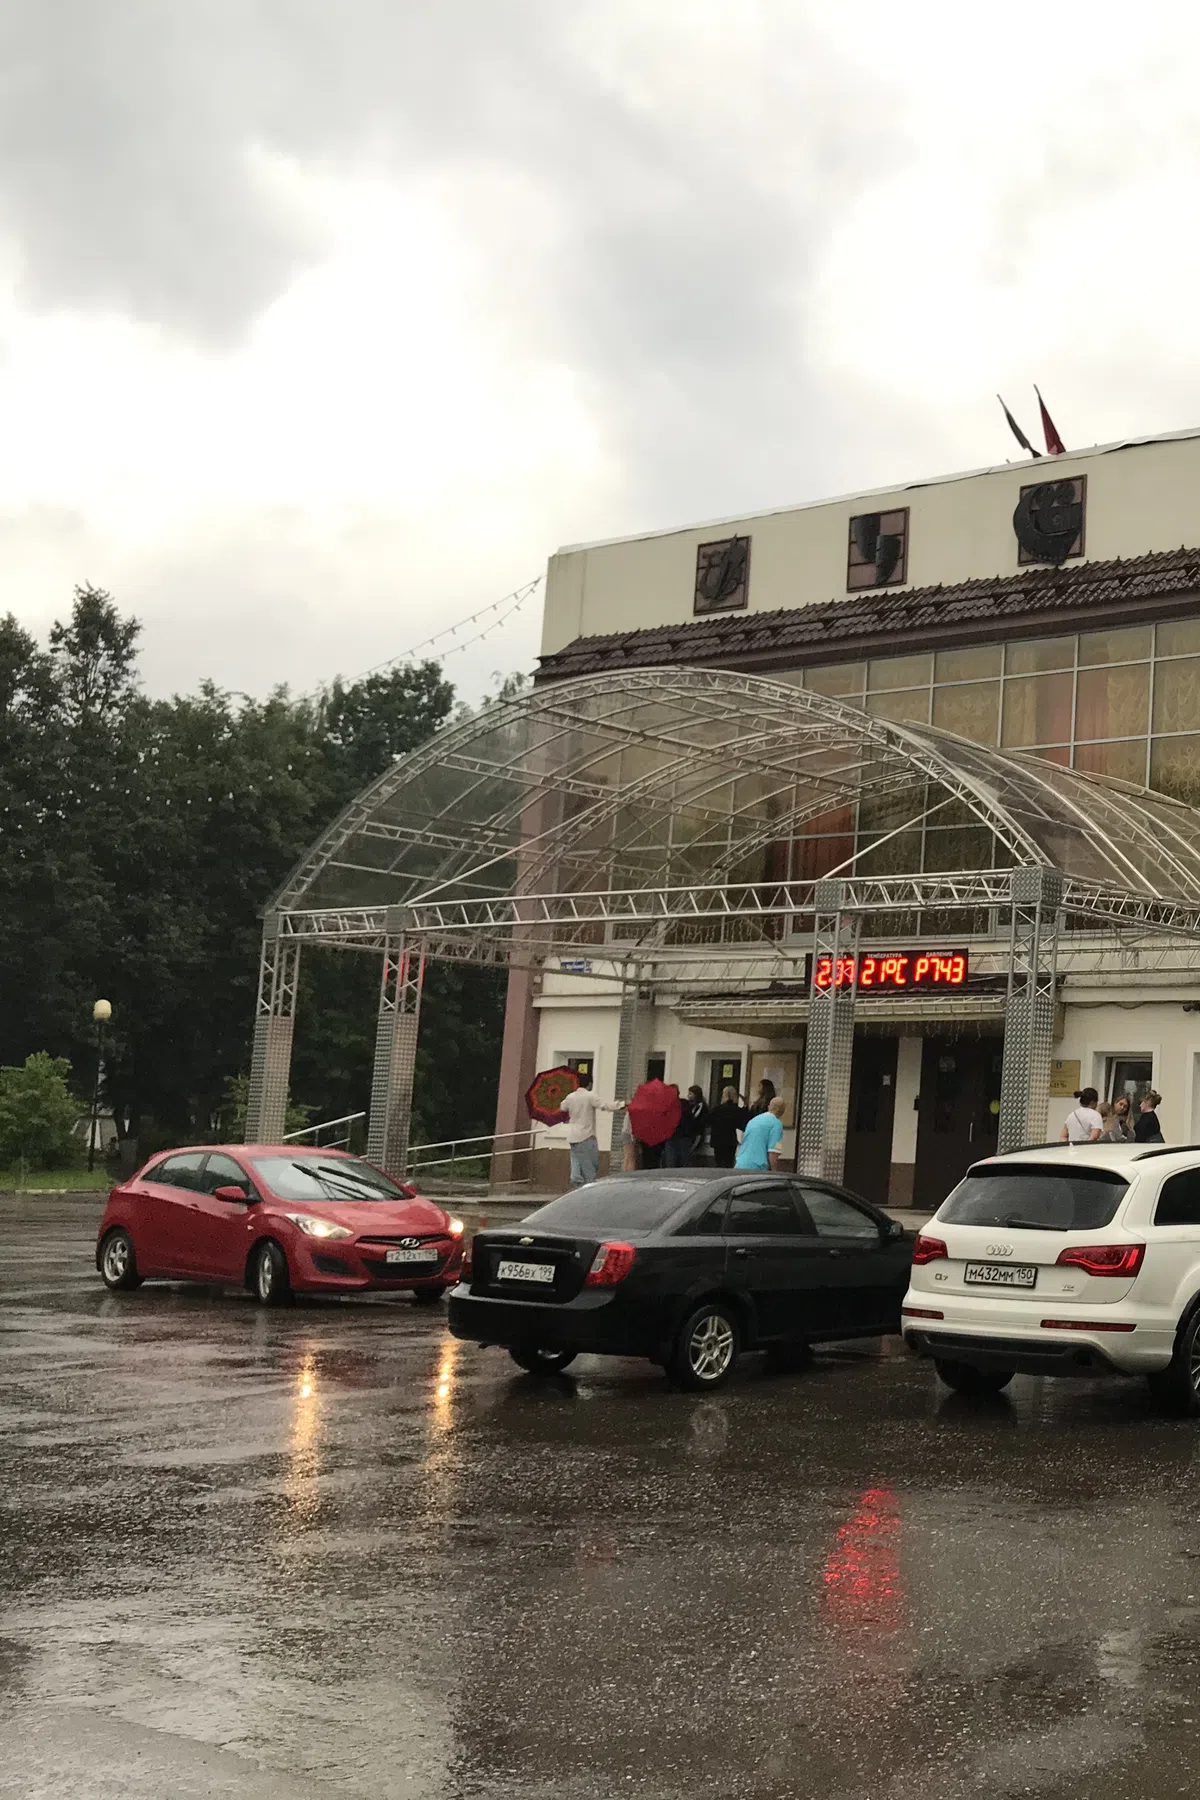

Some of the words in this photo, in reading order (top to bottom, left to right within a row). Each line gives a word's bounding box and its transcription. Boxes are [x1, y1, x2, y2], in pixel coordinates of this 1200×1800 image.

[914, 956, 965, 984] P743
[501, 1264, 537, 1279] К956ВХ
[934, 1273, 949, 1281] Q7
[967, 1267, 1014, 1282] М432ММ
[1016, 1268, 1033, 1280] 150
